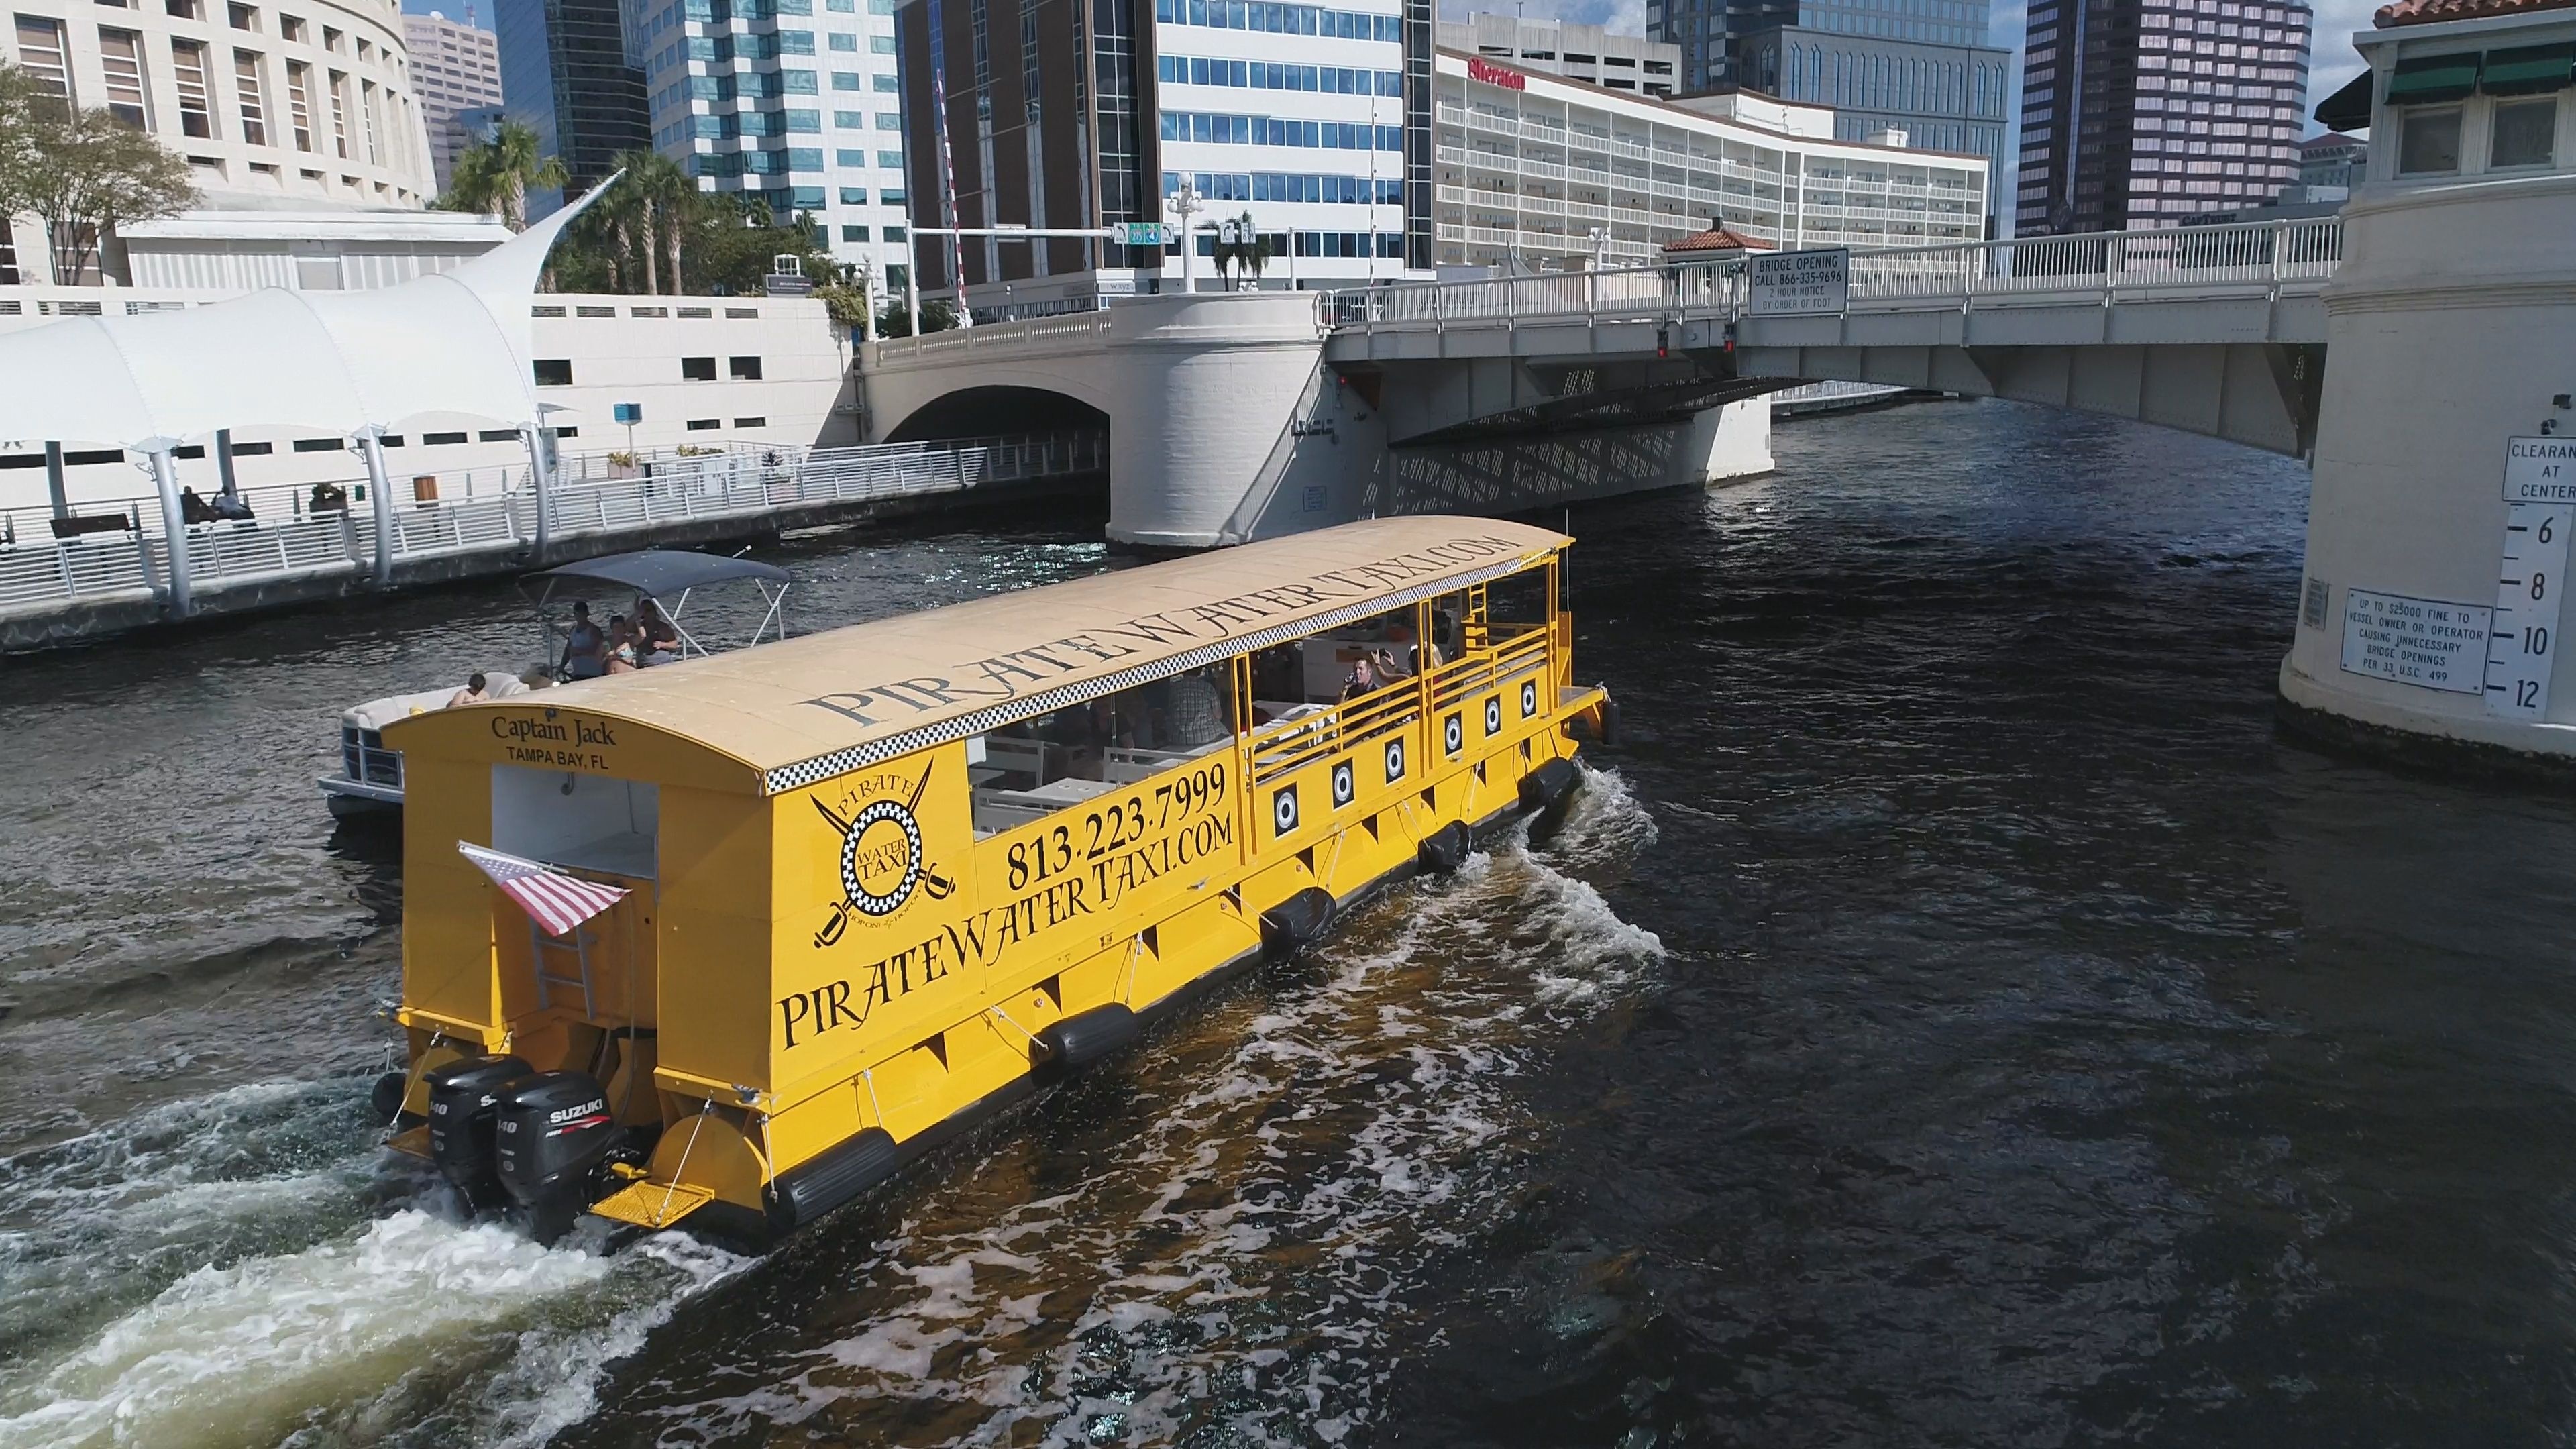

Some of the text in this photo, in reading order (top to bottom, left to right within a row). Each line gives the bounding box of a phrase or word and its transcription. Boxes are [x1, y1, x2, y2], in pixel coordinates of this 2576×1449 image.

[1468, 57, 1525, 91] Sheraton
[1760, 256, 1838, 272] BRIDGE OPENING
[1754, 270, 1842, 286] CALL 866-335-9696
[1763, 300, 1771, 310] BY
[1774, 299, 1798, 309] ORDER
[1801, 299, 1811, 309] OF
[1770, 286, 1825, 298] 2 HOUR NOTICE
[2542, 465, 2560, 478] AT
[2521, 484, 2576, 498] CENTER
[2538, 516, 2554, 544] 6
[2530, 572, 2545, 600] 8
[2359, 598, 2369, 609] UP
[2374, 600, 2383, 612] TO
[2428, 609, 2449, 621] FINE
[2457, 612, 2469, 624] TO
[2349, 612, 2483, 641] VESSEL OWNER OR OPERATOR
[2359, 628, 2461, 653] CAUSING UNNECESSARY
[2524, 627, 2548, 655] 10
[2367, 644, 2445, 666] BRIDGE OPENINGS
[2363, 658, 2448, 682] PER 33 U.S.C. 499
[2516, 679, 2540, 708] 12
[492, 716, 617, 747] Captain Jack
[506, 746, 609, 770] TAMPA BAY, FL
[837, 774, 915, 816] PIRATE
[1007, 762, 1226, 891] 813.223.7999
[857, 837, 907, 865] WATER
[858, 849, 908, 882] TAXI
[549, 1097, 603, 1124] SUZUKI
